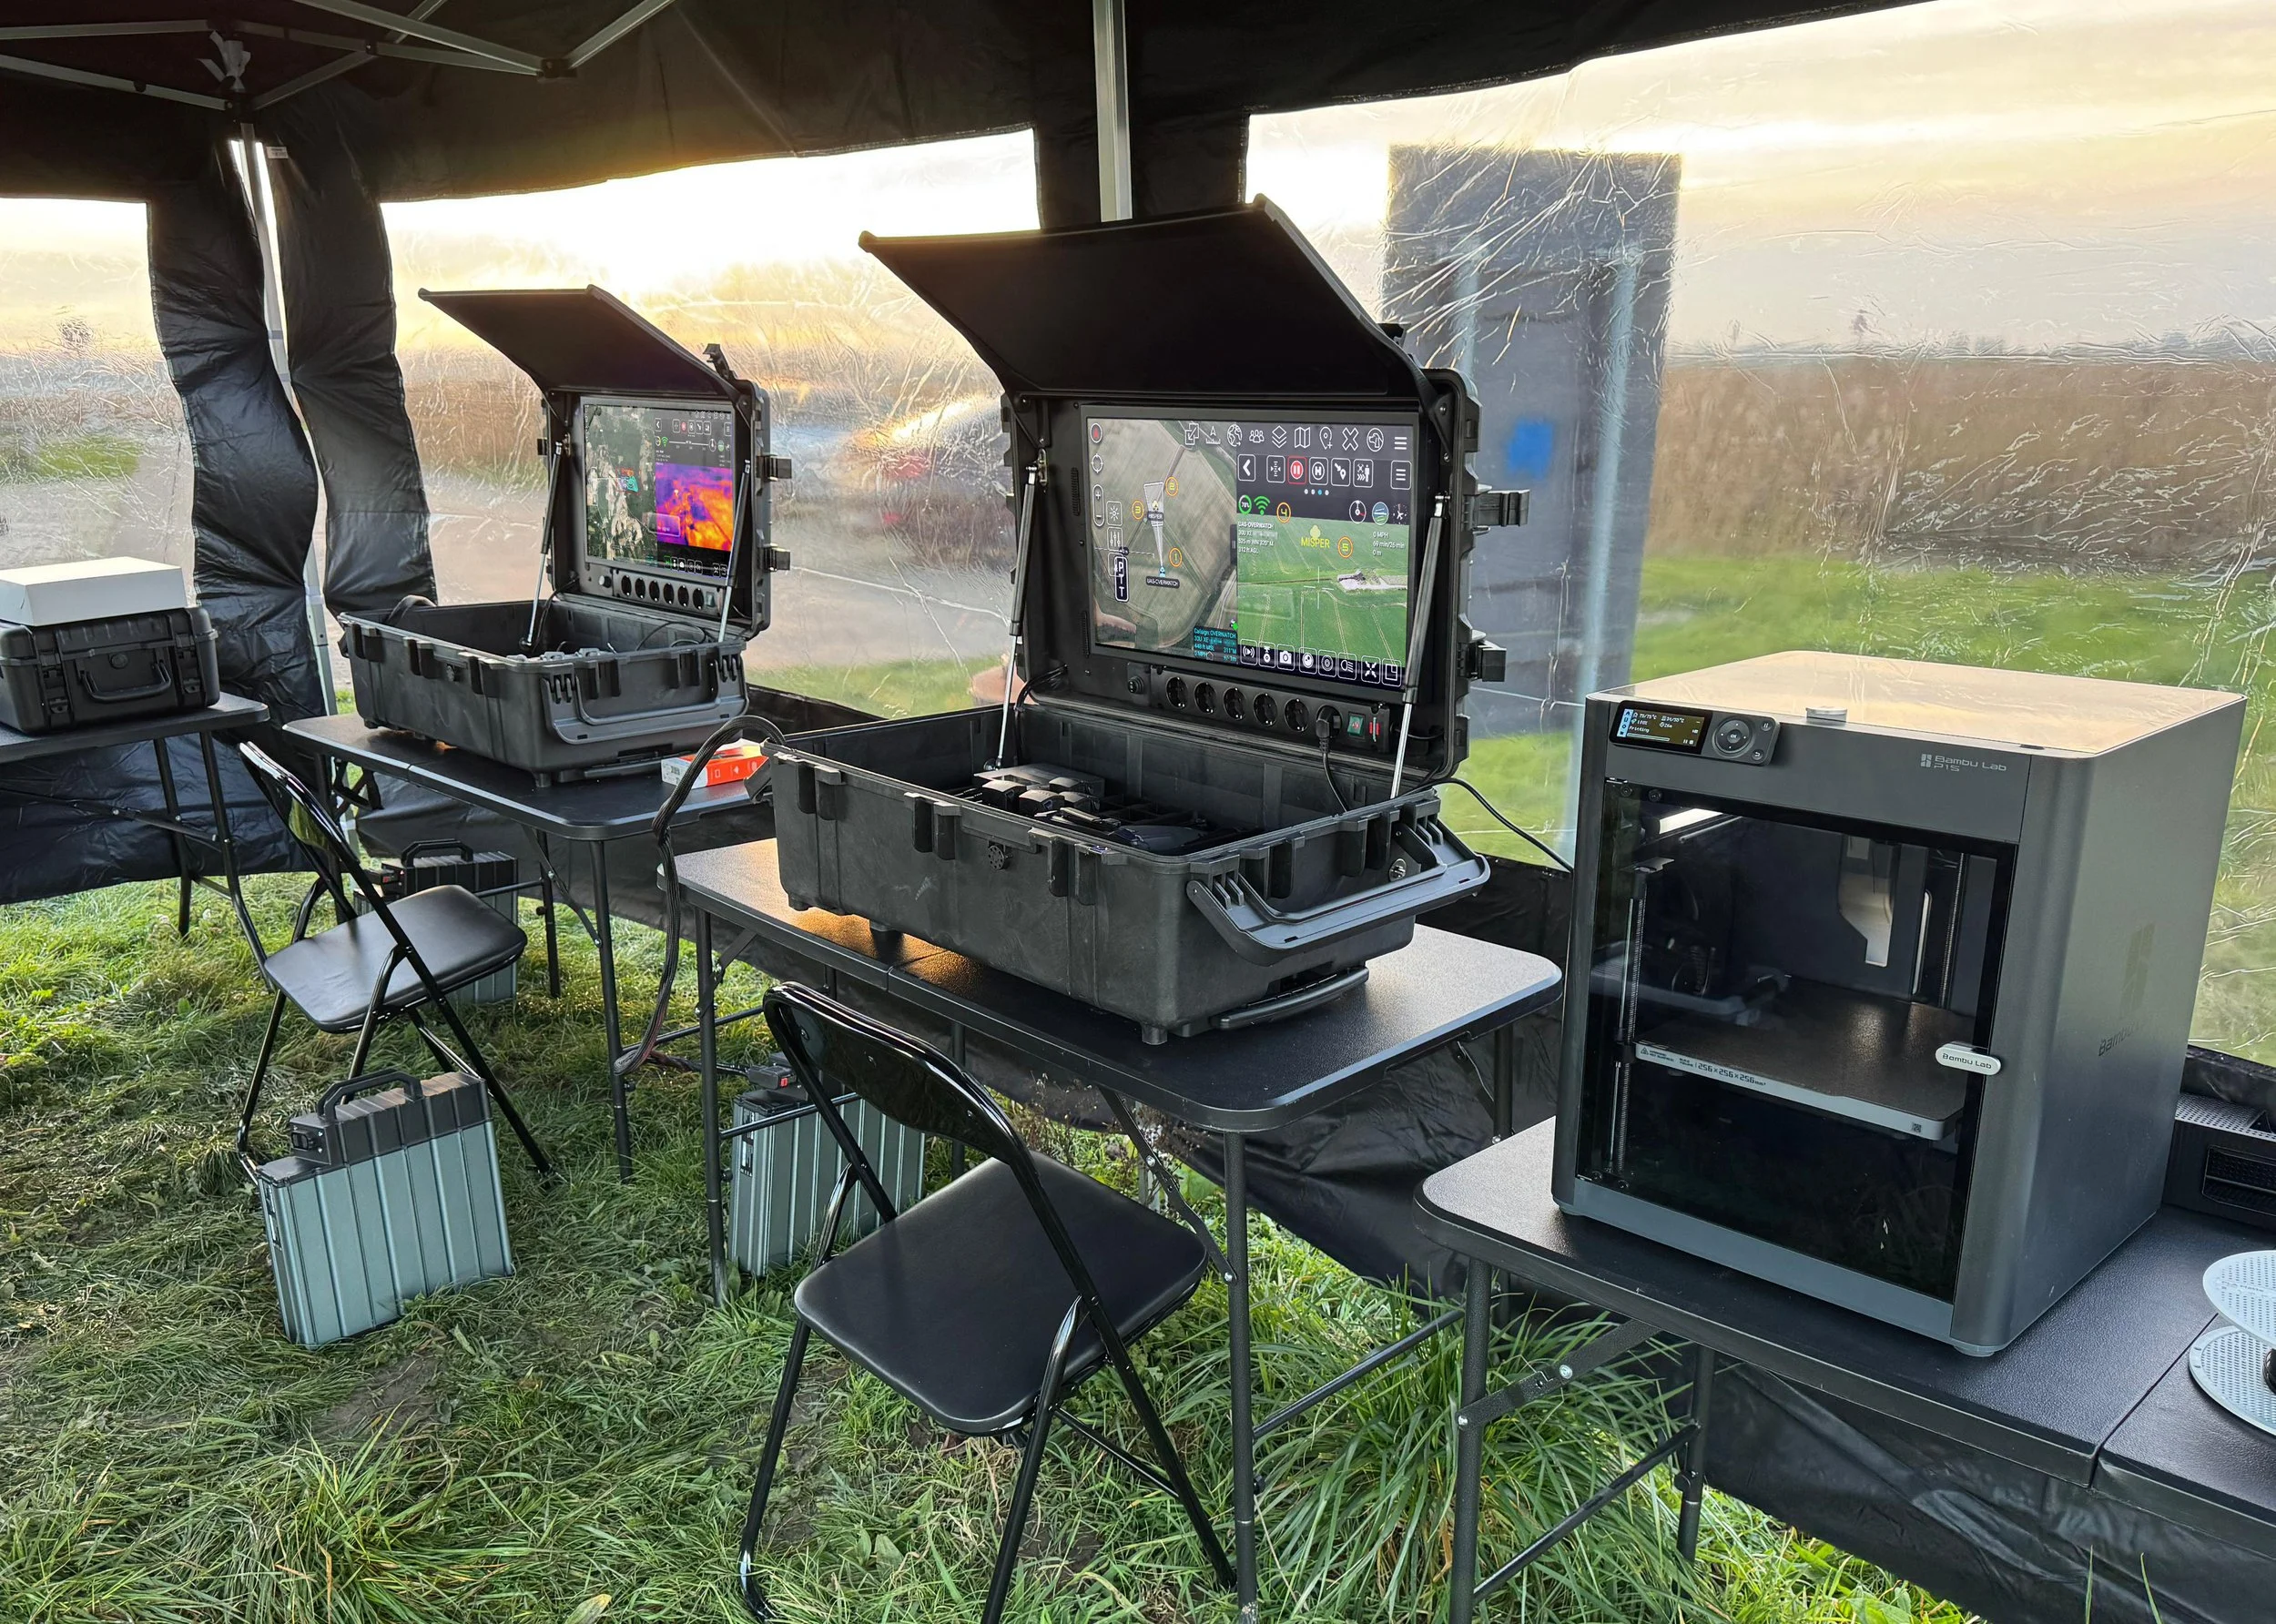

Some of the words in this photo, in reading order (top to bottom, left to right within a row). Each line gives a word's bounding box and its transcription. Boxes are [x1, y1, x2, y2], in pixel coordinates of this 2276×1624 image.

[1134, 505, 1142, 514] 3
[1280, 508, 1287, 517] 4
[1301, 537, 1330, 548] MISPER
[1342, 543, 1349, 552] 5
[1210, 630, 1236, 639] OVERWATCH
[1934, 763, 1960, 772] P1S
[1935, 755, 1978, 767] Bambu
[1982, 761, 2007, 772] Lab
[1942, 1052, 1974, 1065] Bambu
[1975, 1061, 1992, 1070] Lab
